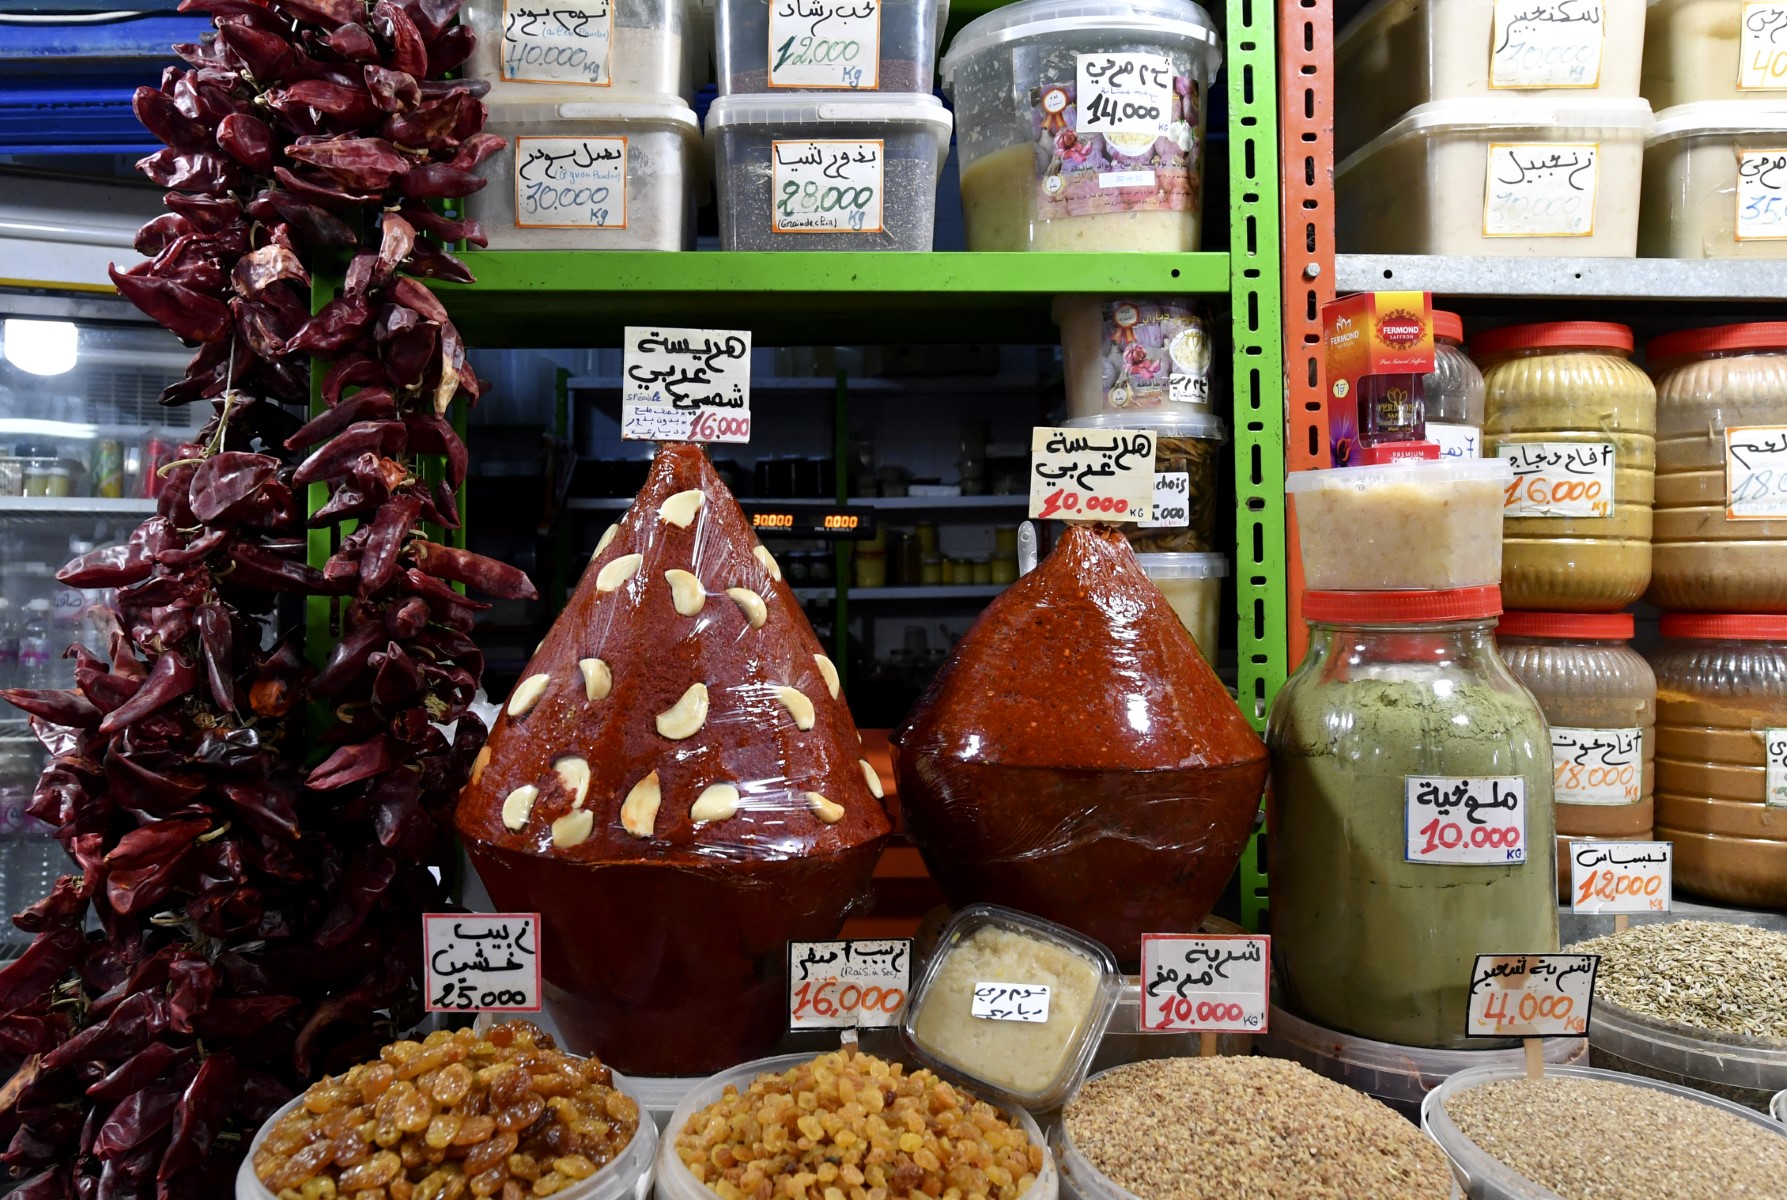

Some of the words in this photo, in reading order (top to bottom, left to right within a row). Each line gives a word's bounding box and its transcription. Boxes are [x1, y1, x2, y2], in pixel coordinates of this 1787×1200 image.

[779, 0, 833, 37] رشاد
[506, 43, 588, 71] 40.000
[1086, 92, 1160, 126] 14.000
[573, 142, 622, 171] بصل
[823, 145, 876, 180] بذور
[525, 182, 610, 214] 30.000
[590, 207, 609, 226] Kg
[1330, 330, 1359, 346] FERMOND
[1383, 326, 1419, 335] FERMOND
[638, 331, 746, 373] هريسة
[628, 364, 711, 400] عربي
[687, 411, 749, 440] 16.000
[1046, 432, 1151, 470] هريسة
[1392, 451, 1425, 459] PREMIUM
[1035, 462, 1115, 491] عربي
[1153, 474, 1187, 494] chois
[1504, 475, 1602, 508] 16.000
[1038, 488, 1128, 518] 10.000
[1130, 508, 1144, 517] KG
[1417, 780, 1518, 824] ملوخية
[1420, 818, 1520, 854] 10.000
[1506, 849, 1522, 859] KG
[854, 942, 906, 973] زبيب
[1185, 941, 1261, 979] شربة
[1471, 956, 1527, 995] شعير
[1530, 957, 1592, 993] شربة
[432, 983, 527, 1010] 25.000
[1156, 995, 1244, 1029] 10.000
